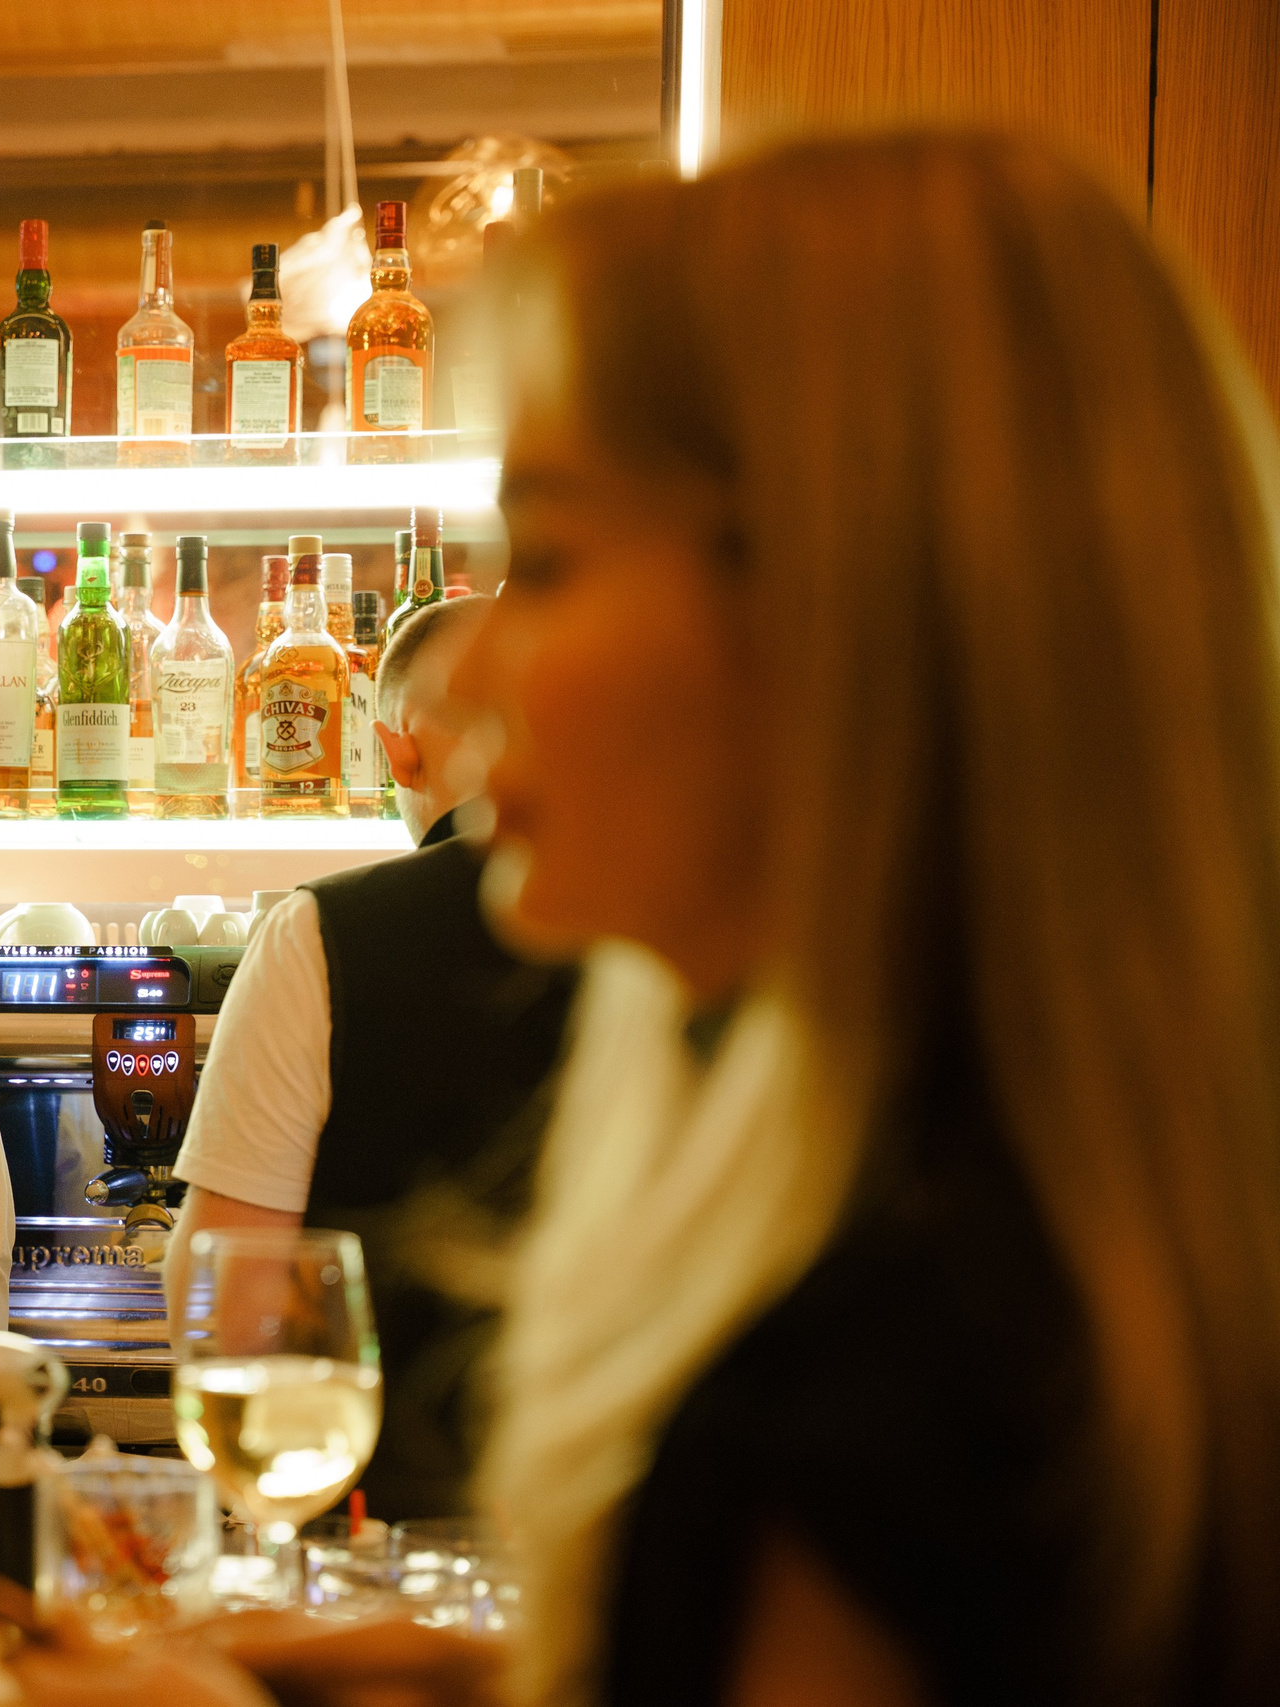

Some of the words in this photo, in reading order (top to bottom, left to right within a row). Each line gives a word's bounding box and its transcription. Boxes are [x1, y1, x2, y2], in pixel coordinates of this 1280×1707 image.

[157, 672, 221, 694] Zacapa
[180, 702, 196, 712] 23
[264, 701, 315, 717] CHIVAS
[299, 781, 315, 794] 12
[89, 947, 149, 956] PASSION
[12, 974, 57, 996] 111
[72, 1377, 107, 1393] 40
